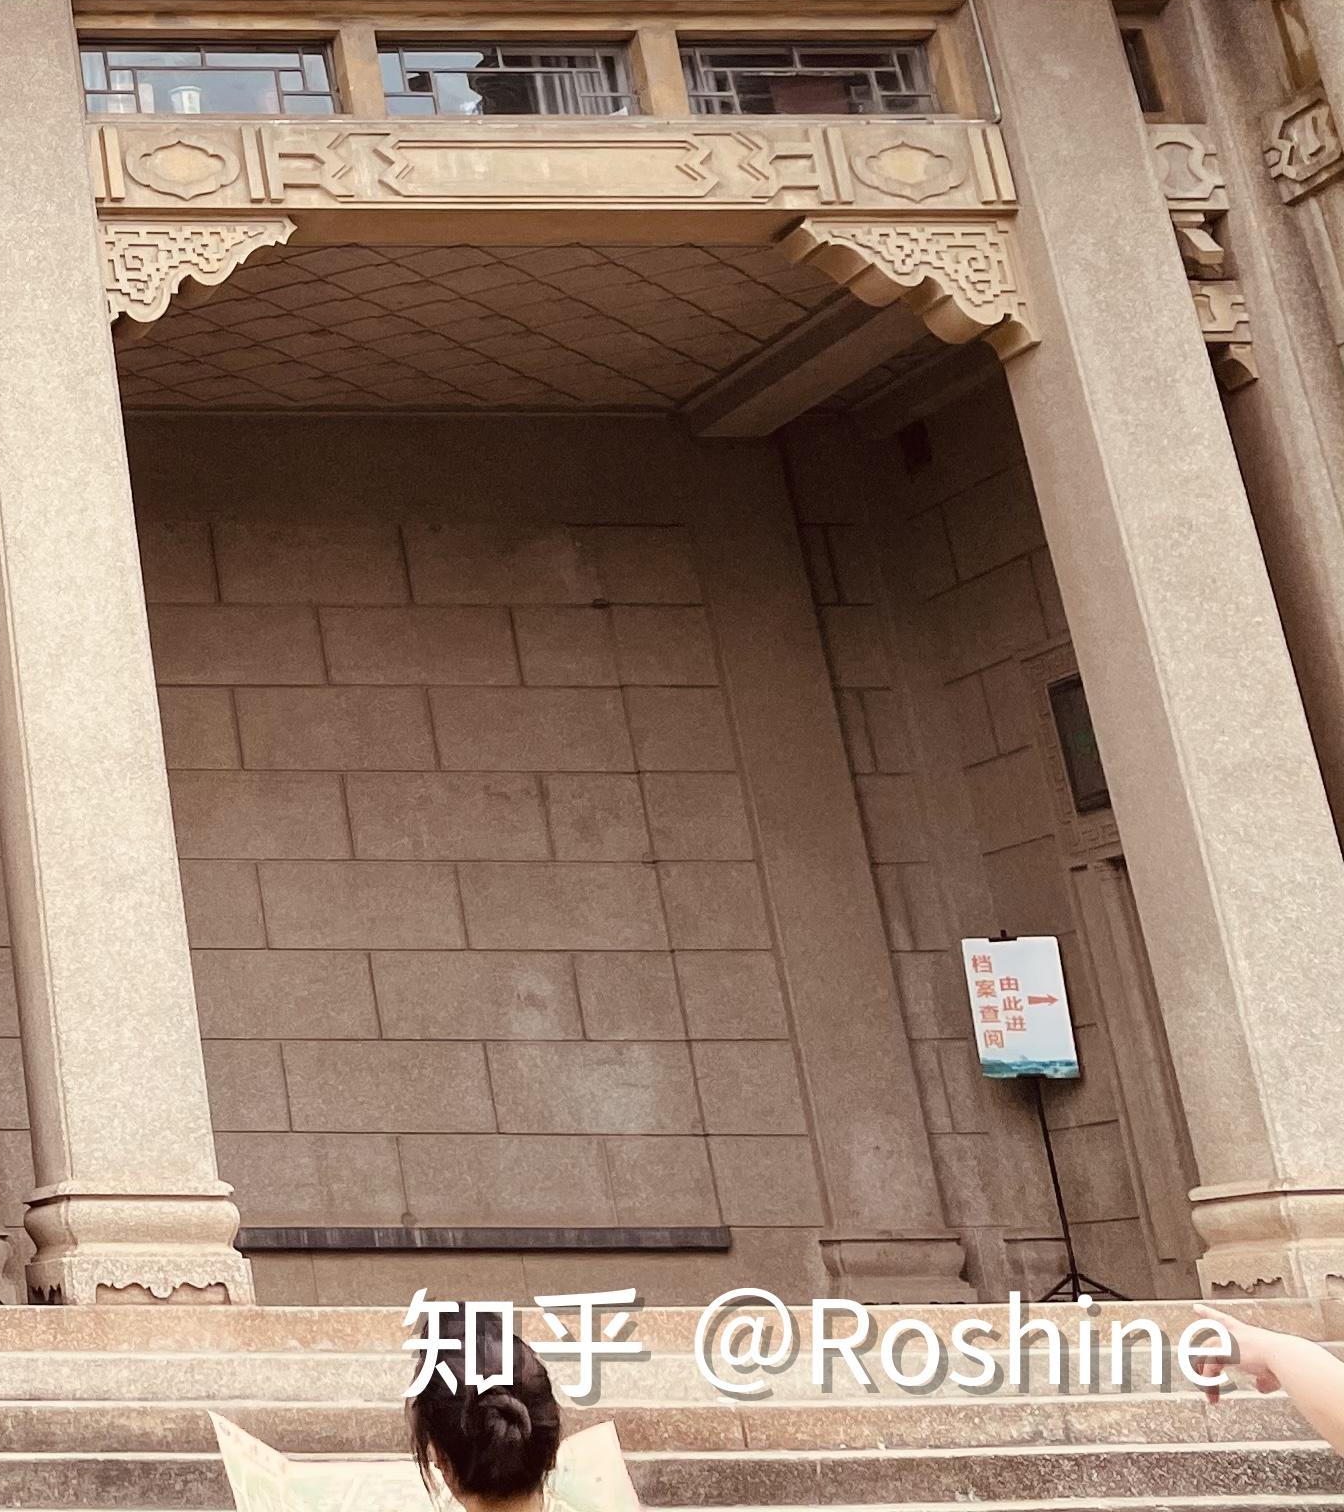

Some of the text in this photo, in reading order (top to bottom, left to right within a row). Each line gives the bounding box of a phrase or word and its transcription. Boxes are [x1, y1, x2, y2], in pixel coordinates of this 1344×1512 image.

[971, 954, 1004, 1048] 档案查阅
[999, 976, 1026, 1032] 由此进
